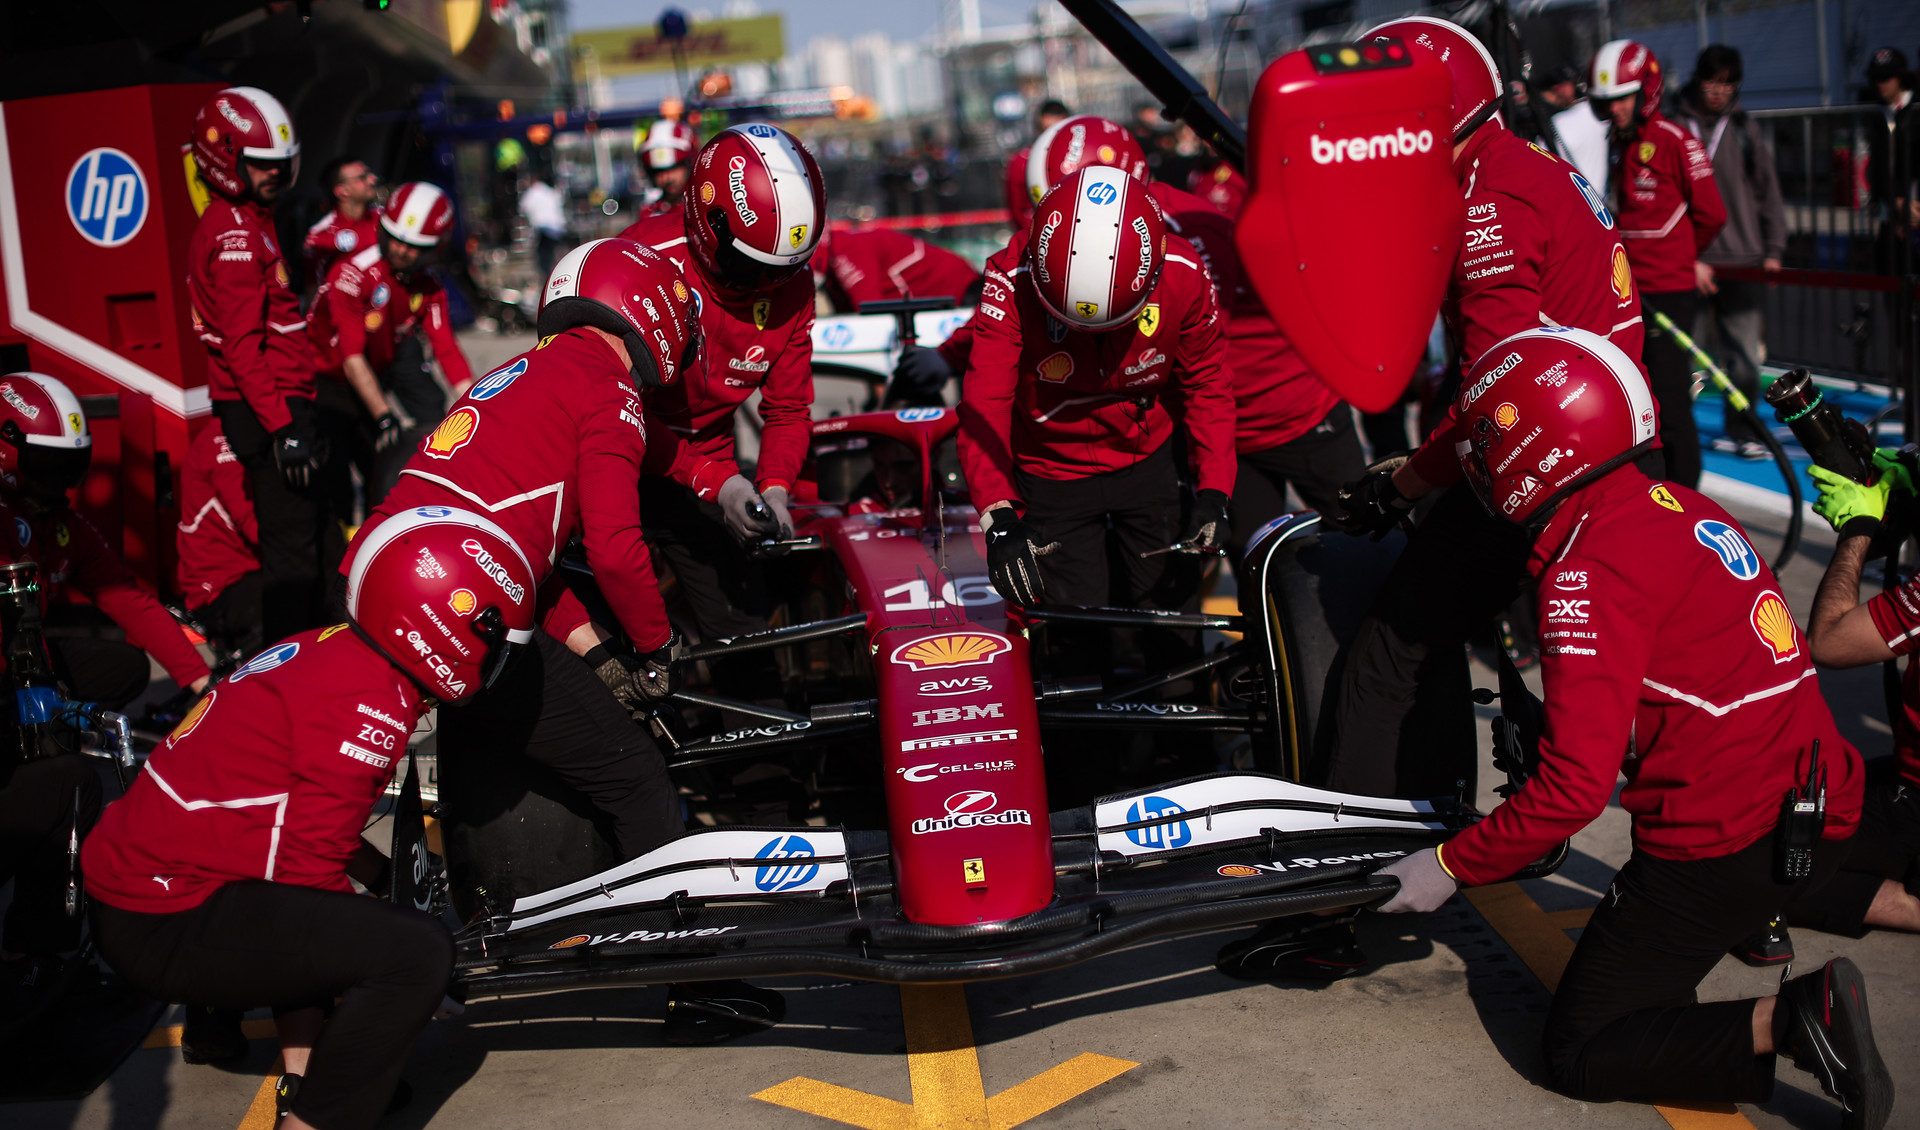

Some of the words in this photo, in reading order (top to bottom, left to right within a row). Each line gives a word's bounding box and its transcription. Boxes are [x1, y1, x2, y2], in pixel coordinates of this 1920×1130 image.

[1310, 127, 1433, 164] brembo
[78, 150, 138, 246] hp
[729, 170, 758, 228] UniCredit
[1089, 182, 1115, 205] hp
[1467, 203, 1496, 217] aws
[1132, 216, 1152, 278] UniCredit
[1465, 224, 1503, 247] DXC
[1467, 241, 1504, 253] TECHNOLOGY
[1038, 223, 1055, 283] UniCredit
[1463, 254, 1492, 268] RICHARD
[1493, 249, 1514, 260] MILLE
[552, 276, 569, 287] BELL
[1466, 263, 1515, 281] HCLSoftware
[982, 283, 1006, 302] ZCG
[621, 305, 641, 329] FALCONI
[656, 285, 676, 319] RICHARD
[674, 318, 684, 343] MILLE
[1469, 352, 1523, 403] UniCredit
[1535, 360, 1568, 386] PERONI
[1497, 446, 1522, 474] RICHARD
[1521, 425, 1543, 449] MILLE
[1555, 469, 1584, 487] GHELLER
[418, 547, 448, 579] PERONI
[1697, 521, 1753, 580] hp
[476, 548, 525, 605] UniCredit
[1556, 571, 1588, 583] aws
[884, 576, 1004, 612] 16
[1548, 599, 1591, 617] DXC
[421, 603, 451, 637] RICHARD
[449, 635, 471, 657] MILLE
[919, 676, 989, 692] aws
[912, 702, 1005, 727] IBM
[1096, 703, 1198, 714] ESPACIO
[357, 723, 395, 750] ZCG
[710, 721, 812, 744] ESPACIO
[901, 729, 1019, 752] PIRELLI
[339, 740, 391, 769] PIRELLI
[912, 809, 1031, 835] UniCredit
[1135, 797, 1183, 849] hp
[757, 835, 816, 892] hp
[1253, 849, 1408, 873] V-Power
[590, 924, 739, 946] V-Power
